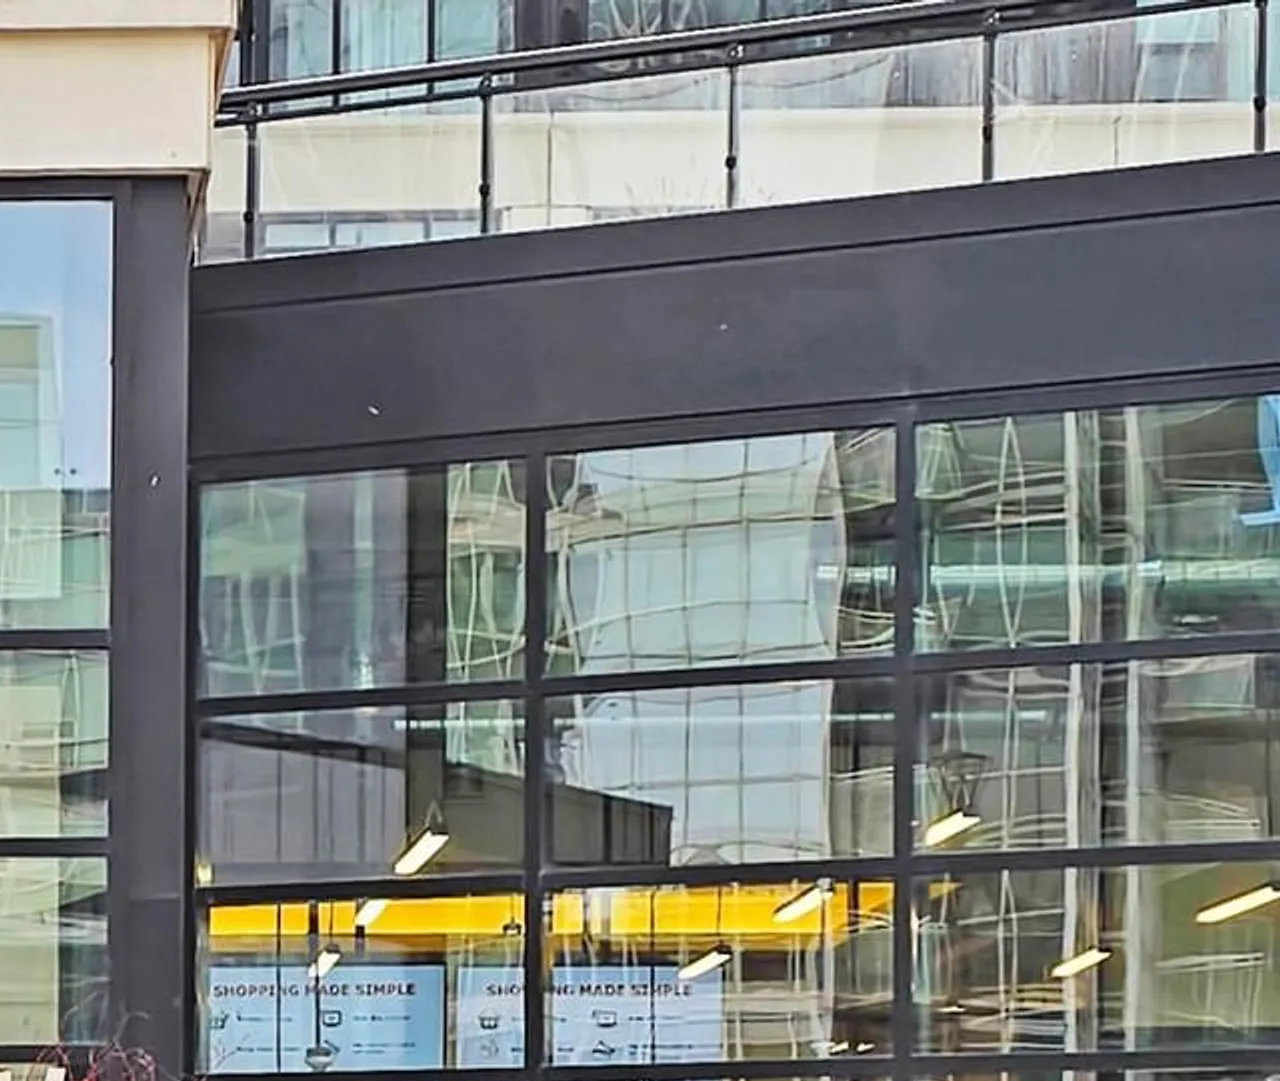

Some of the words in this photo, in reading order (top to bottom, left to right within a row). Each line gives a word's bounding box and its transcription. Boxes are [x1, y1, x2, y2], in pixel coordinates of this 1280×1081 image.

[355, 982, 416, 996] SIMPLE
[486, 984, 574, 997] SHONG
[579, 984, 625, 997] MADE
